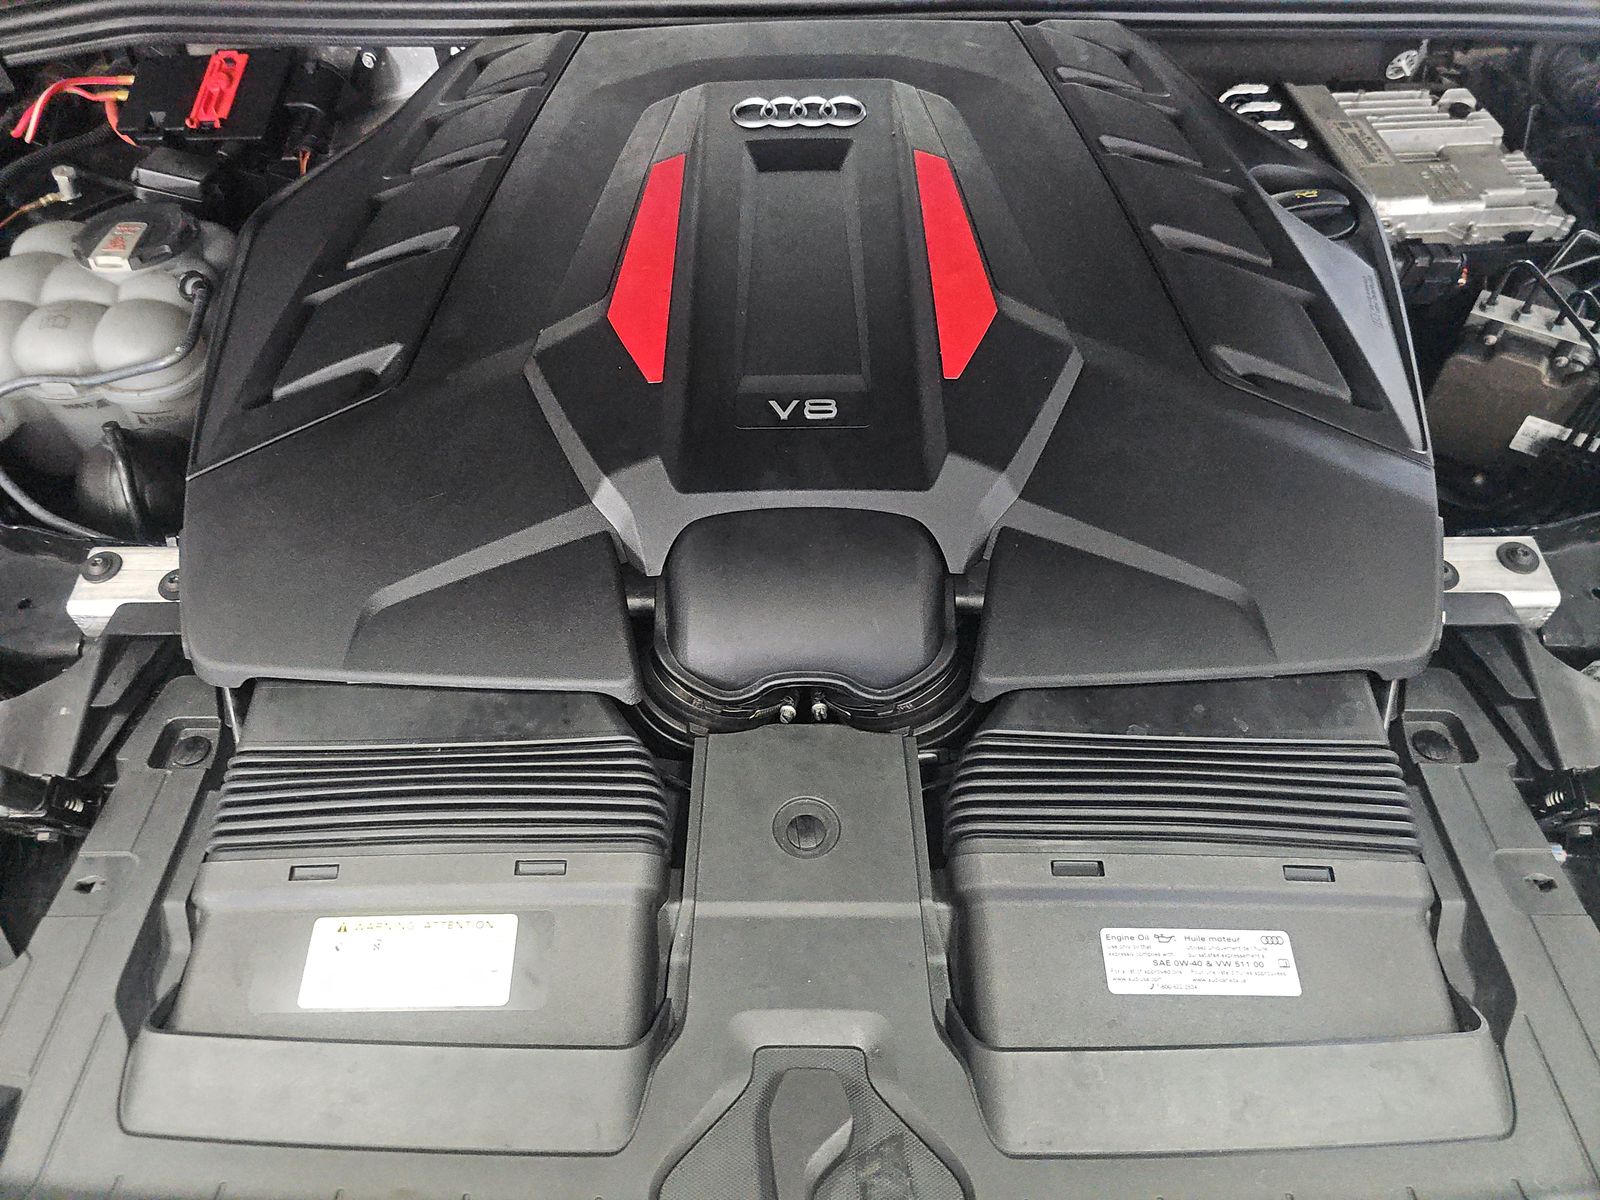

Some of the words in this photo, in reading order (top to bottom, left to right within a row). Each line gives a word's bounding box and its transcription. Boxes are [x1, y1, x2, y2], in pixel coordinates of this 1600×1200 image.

[768, 399, 838, 420] V8
[1105, 933, 1135, 942] Engine
[1184, 935, 1206, 943] Huile
[1152, 959, 1172, 967] SAE
